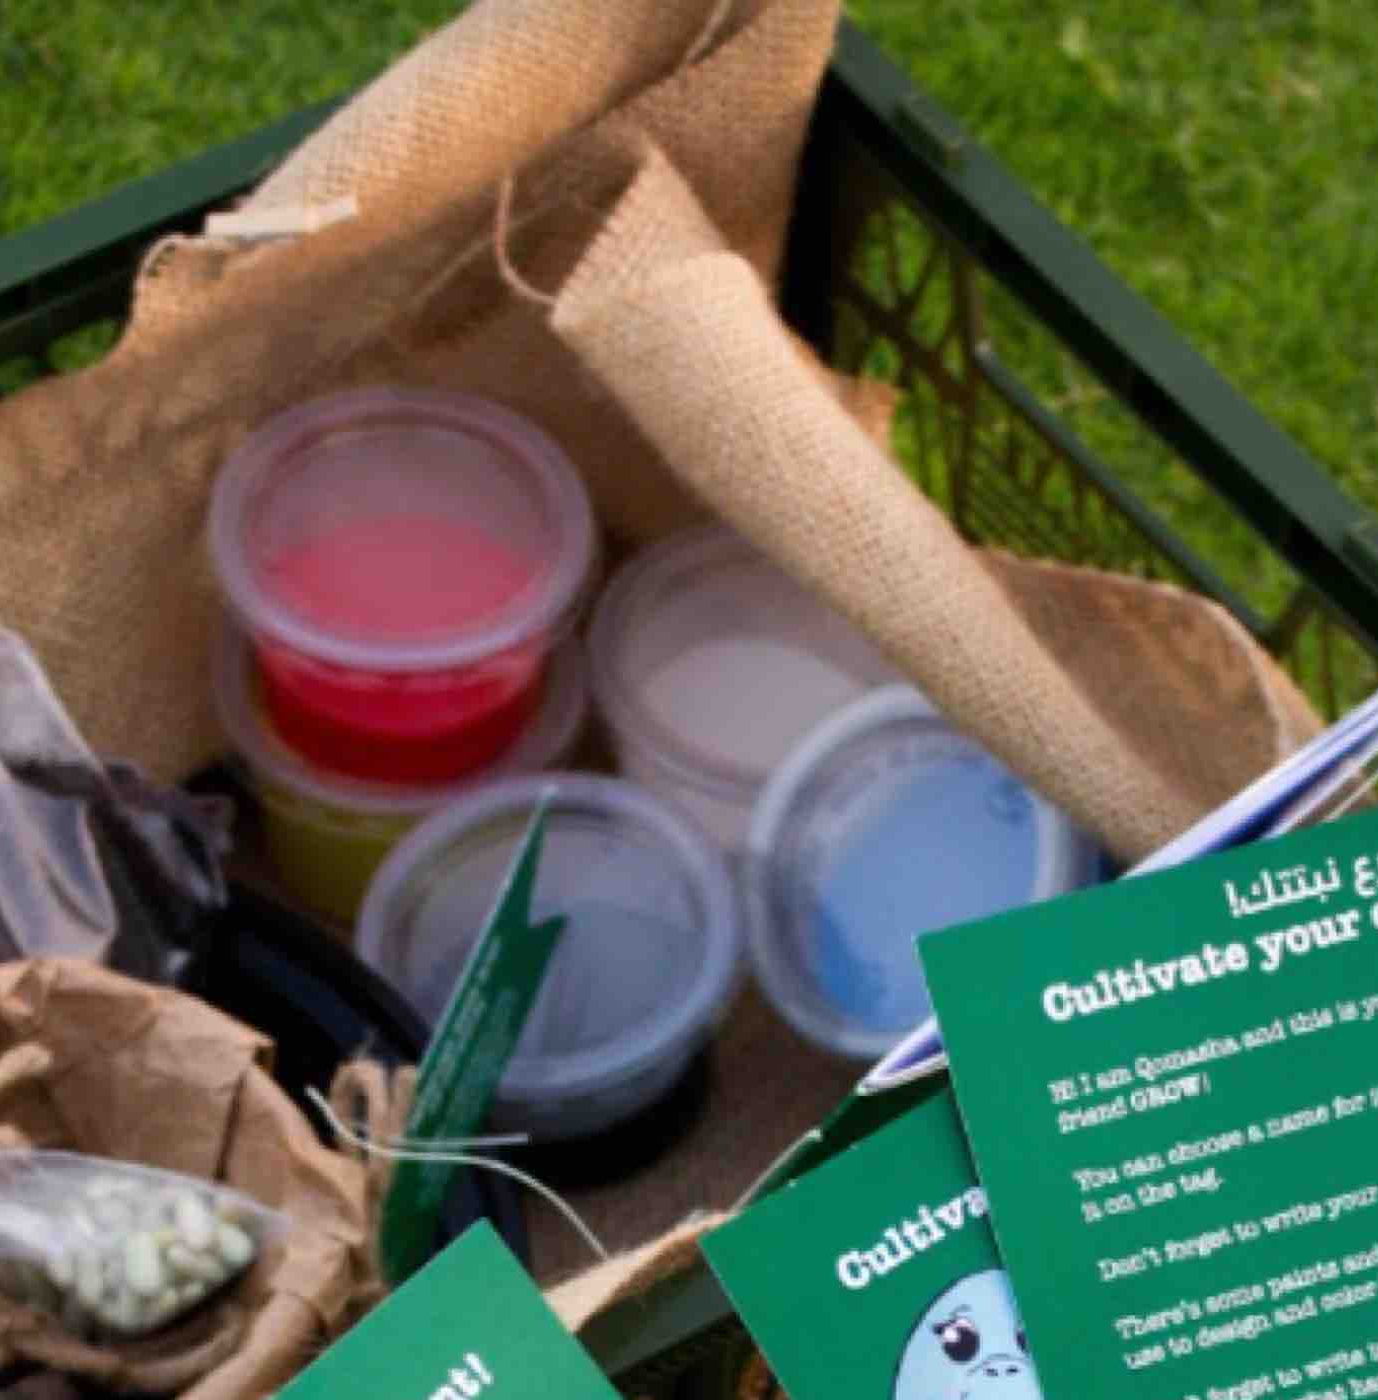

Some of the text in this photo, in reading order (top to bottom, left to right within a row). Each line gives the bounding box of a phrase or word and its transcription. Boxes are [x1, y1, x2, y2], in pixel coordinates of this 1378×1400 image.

[1042, 942, 1249, 1021] Cultivate
[1254, 908, 1360, 972] your
[1077, 1072, 1094, 1096] I
[1094, 1065, 1135, 1090] am
[1240, 1018, 1287, 1050] and
[1288, 1007, 1334, 1035] this
[1335, 1000, 1359, 1022] is
[1057, 1095, 1129, 1134] friend
[1071, 1167, 1119, 1191] You
[1118, 1153, 1166, 1178] can
[1166, 1129, 1246, 1164] choose
[1246, 1124, 1265, 1143] a
[1265, 1104, 1330, 1137] name
[1331, 1093, 1367, 1119] for
[1080, 1200, 1105, 1223] it
[1103, 1192, 1137, 1215] on
[1136, 1181, 1177, 1206] the
[1097, 1247, 1162, 1281] Don't
[1163, 1227, 1233, 1262] forget
[1232, 1220, 1261, 1241] to
[1260, 1202, 1324, 1232] write
[1322, 1184, 1378, 1221] your
[1113, 1299, 1204, 1339] There's
[1203, 1284, 1264, 1314] some
[1266, 1260, 1341, 1300] paints
[1123, 1344, 1166, 1369] use
[1165, 1334, 1193, 1357] to
[1194, 1314, 1272, 1348] design
[1271, 1295, 1318, 1325] and
[1319, 1280, 1378, 1312] color
[1275, 1367, 1303, 1388] to
[1303, 1348, 1366, 1379] write
